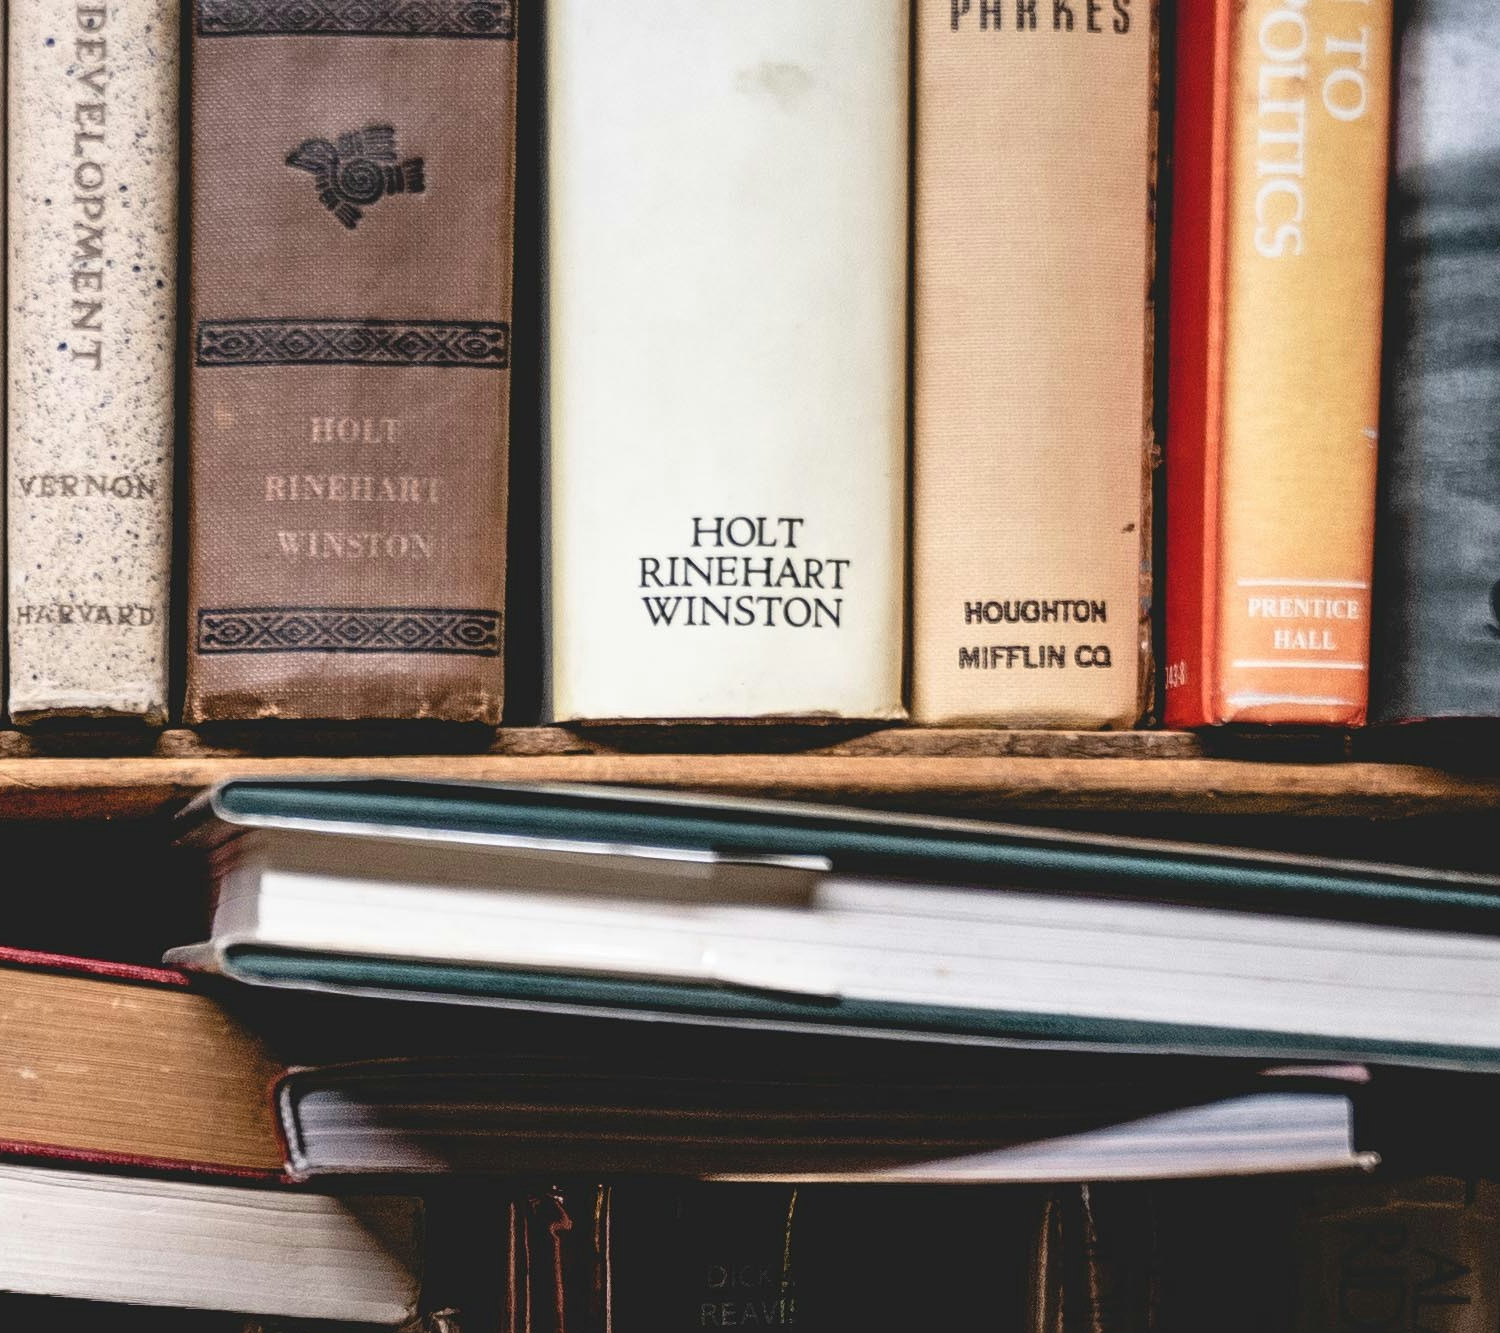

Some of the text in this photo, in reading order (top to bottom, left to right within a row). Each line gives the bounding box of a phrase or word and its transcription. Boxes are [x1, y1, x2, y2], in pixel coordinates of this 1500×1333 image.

[19, 475, 156, 498] VERNON
[691, 517, 803, 550] HOLT
[639, 556, 850, 589] RINEHART
[17, 603, 154, 627] HARVARD
[647, 597, 843, 627] WINSTON
[963, 600, 1107, 625] HOUGHTON
